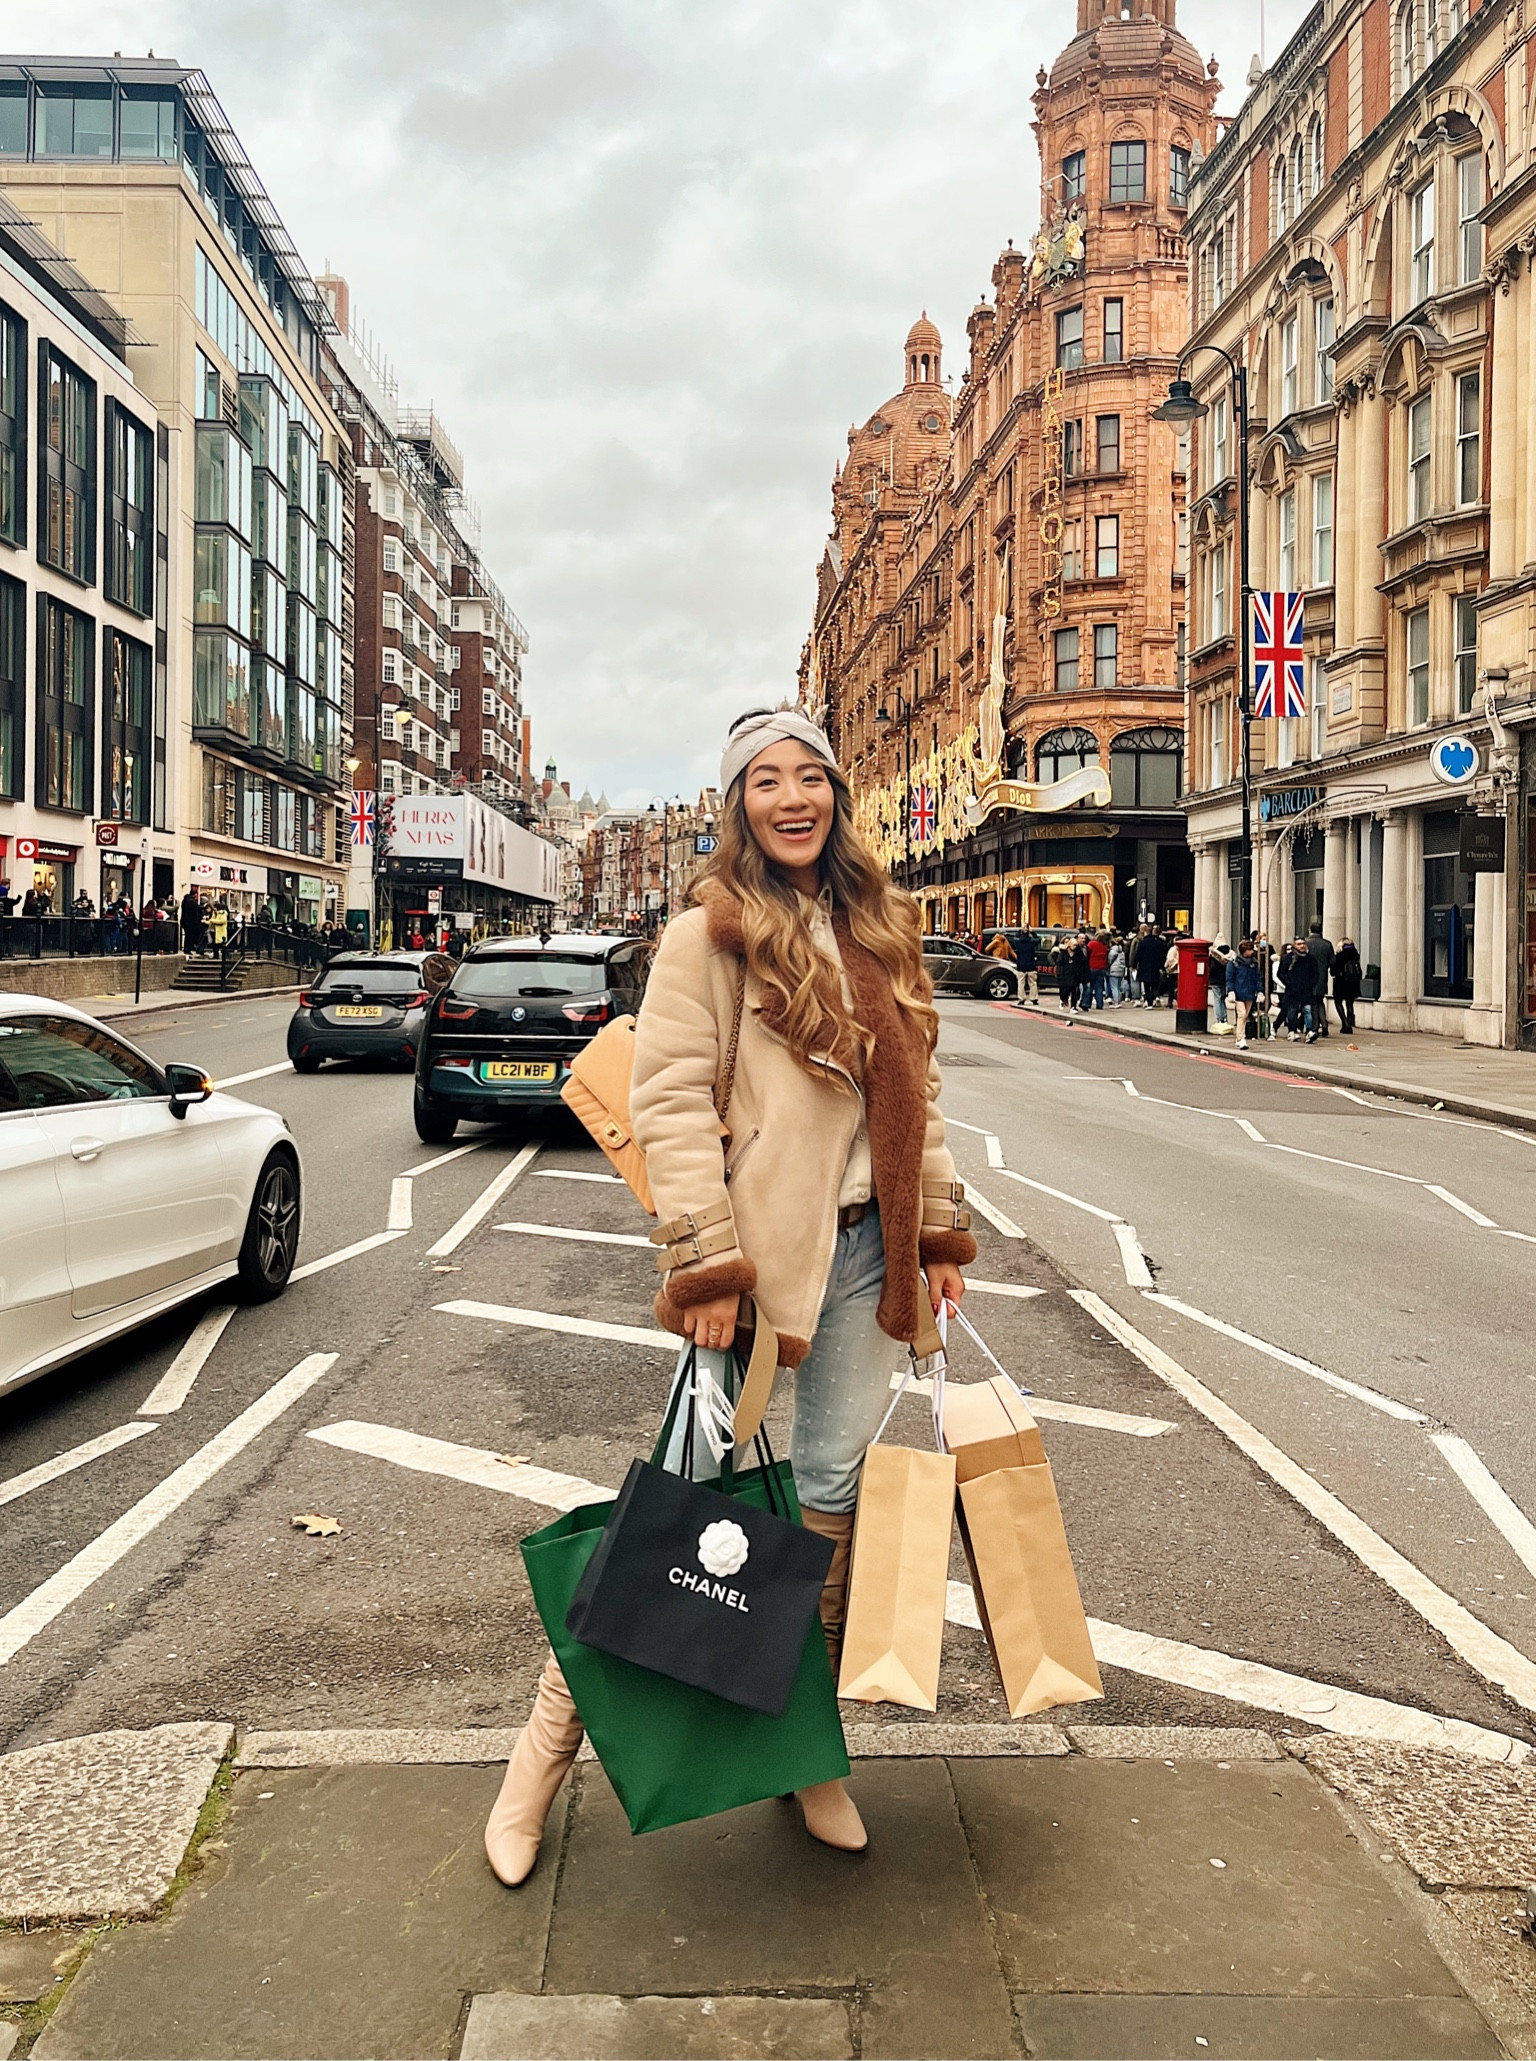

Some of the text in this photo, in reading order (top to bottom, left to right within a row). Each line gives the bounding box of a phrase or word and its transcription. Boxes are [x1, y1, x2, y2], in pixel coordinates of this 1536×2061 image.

[1040, 366, 1063, 619] HARRODS
[1009, 788, 1032, 806] DIOR
[1271, 786, 1317, 816] BARCLAY
[402, 810, 456, 824] MERRY
[406, 830, 454, 845] XMAS
[701, 838, 709, 850] P
[1466, 851, 1498, 859] Church's
[339, 1006, 379, 1014] FE72 XSG
[492, 1064, 549, 1077] LC21 WBF
[668, 1567, 750, 1613] CHANEL
